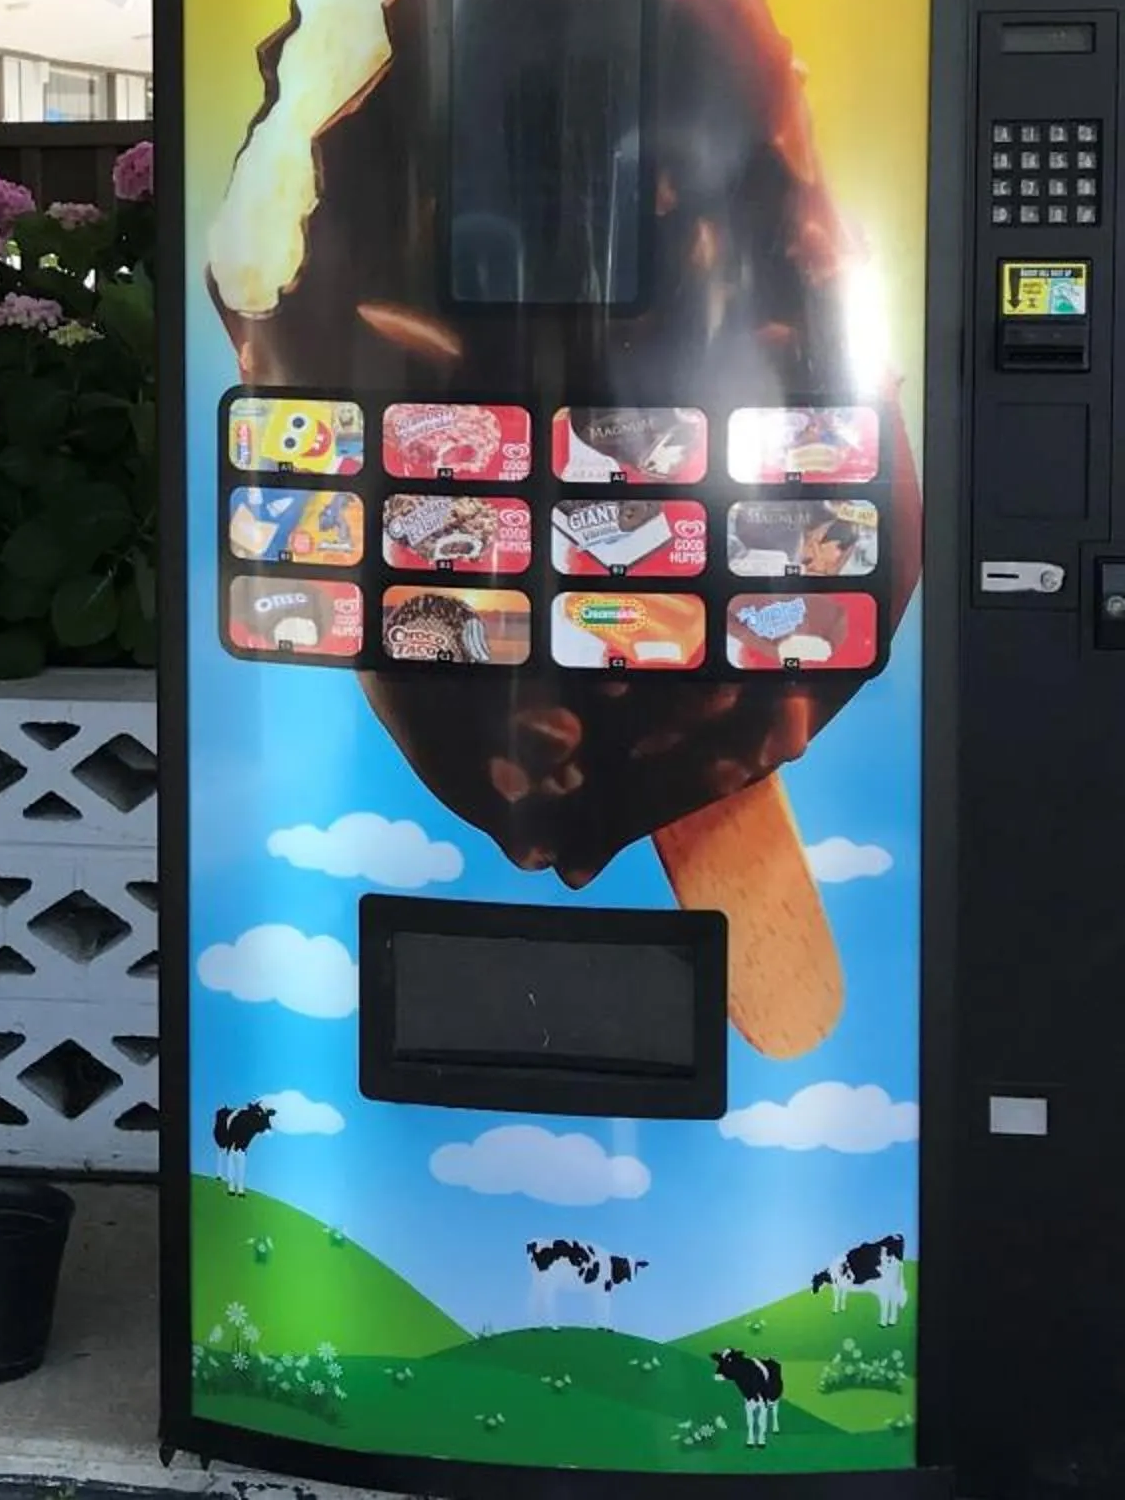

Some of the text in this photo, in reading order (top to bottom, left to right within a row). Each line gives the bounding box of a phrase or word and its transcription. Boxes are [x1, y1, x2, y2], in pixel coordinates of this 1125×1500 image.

[589, 418, 654, 438] MAGNUM
[569, 504, 620, 530] GIANT
[675, 539, 704, 551] GOOD
[393, 643, 438, 660] TACO
